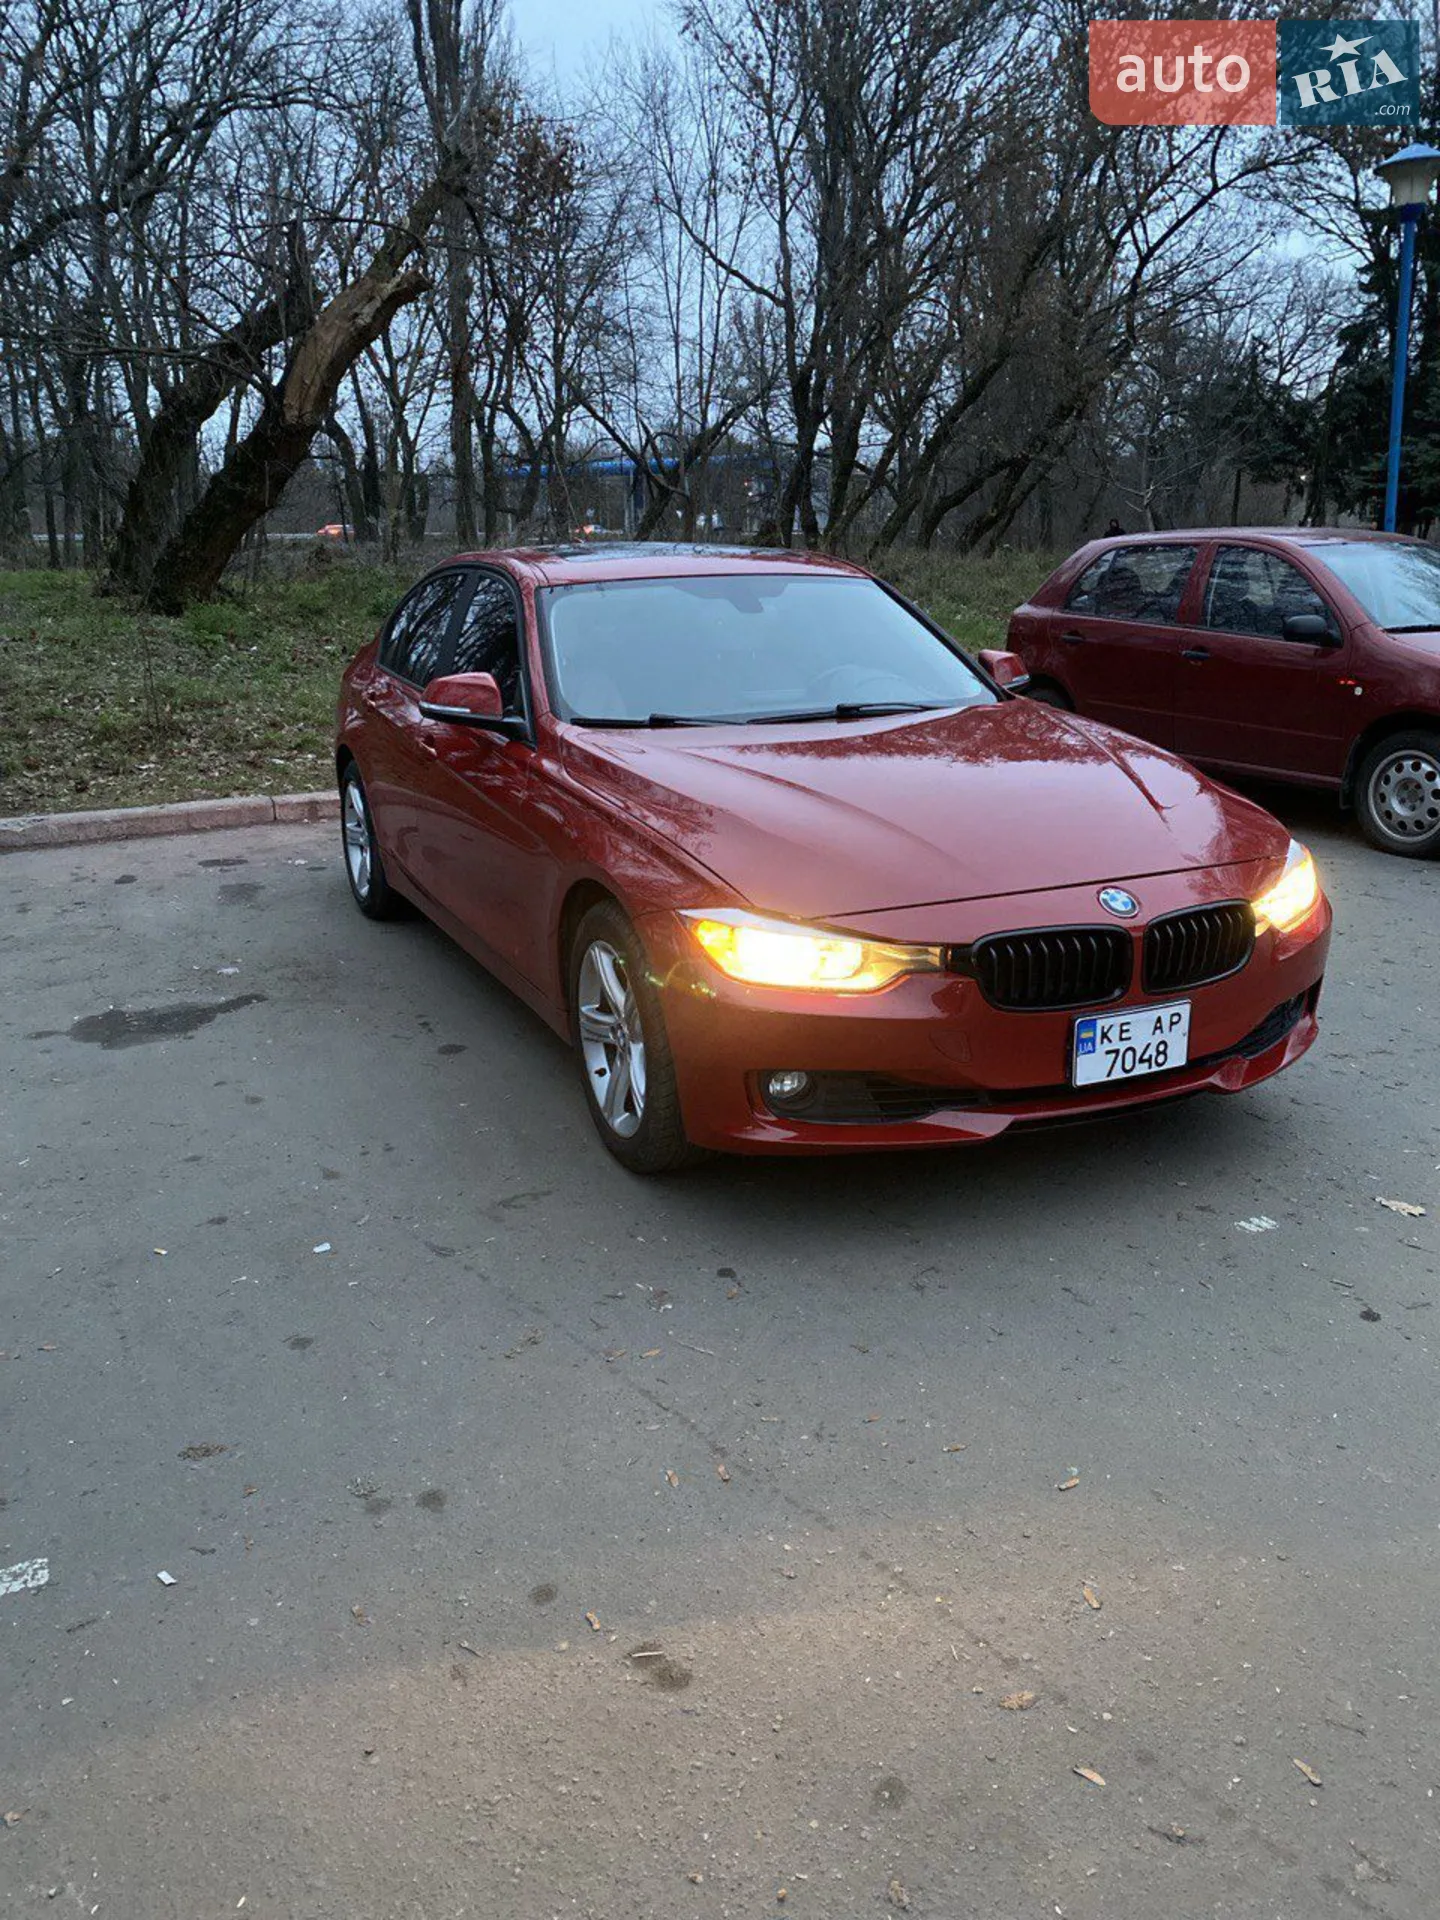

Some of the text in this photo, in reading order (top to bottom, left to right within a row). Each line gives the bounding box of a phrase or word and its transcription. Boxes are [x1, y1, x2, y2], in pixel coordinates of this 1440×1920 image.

[1100, 1011, 1182, 1045] KE AP
[1079, 1041, 1095, 1054] UA
[1105, 1040, 1169, 1078] 7048
